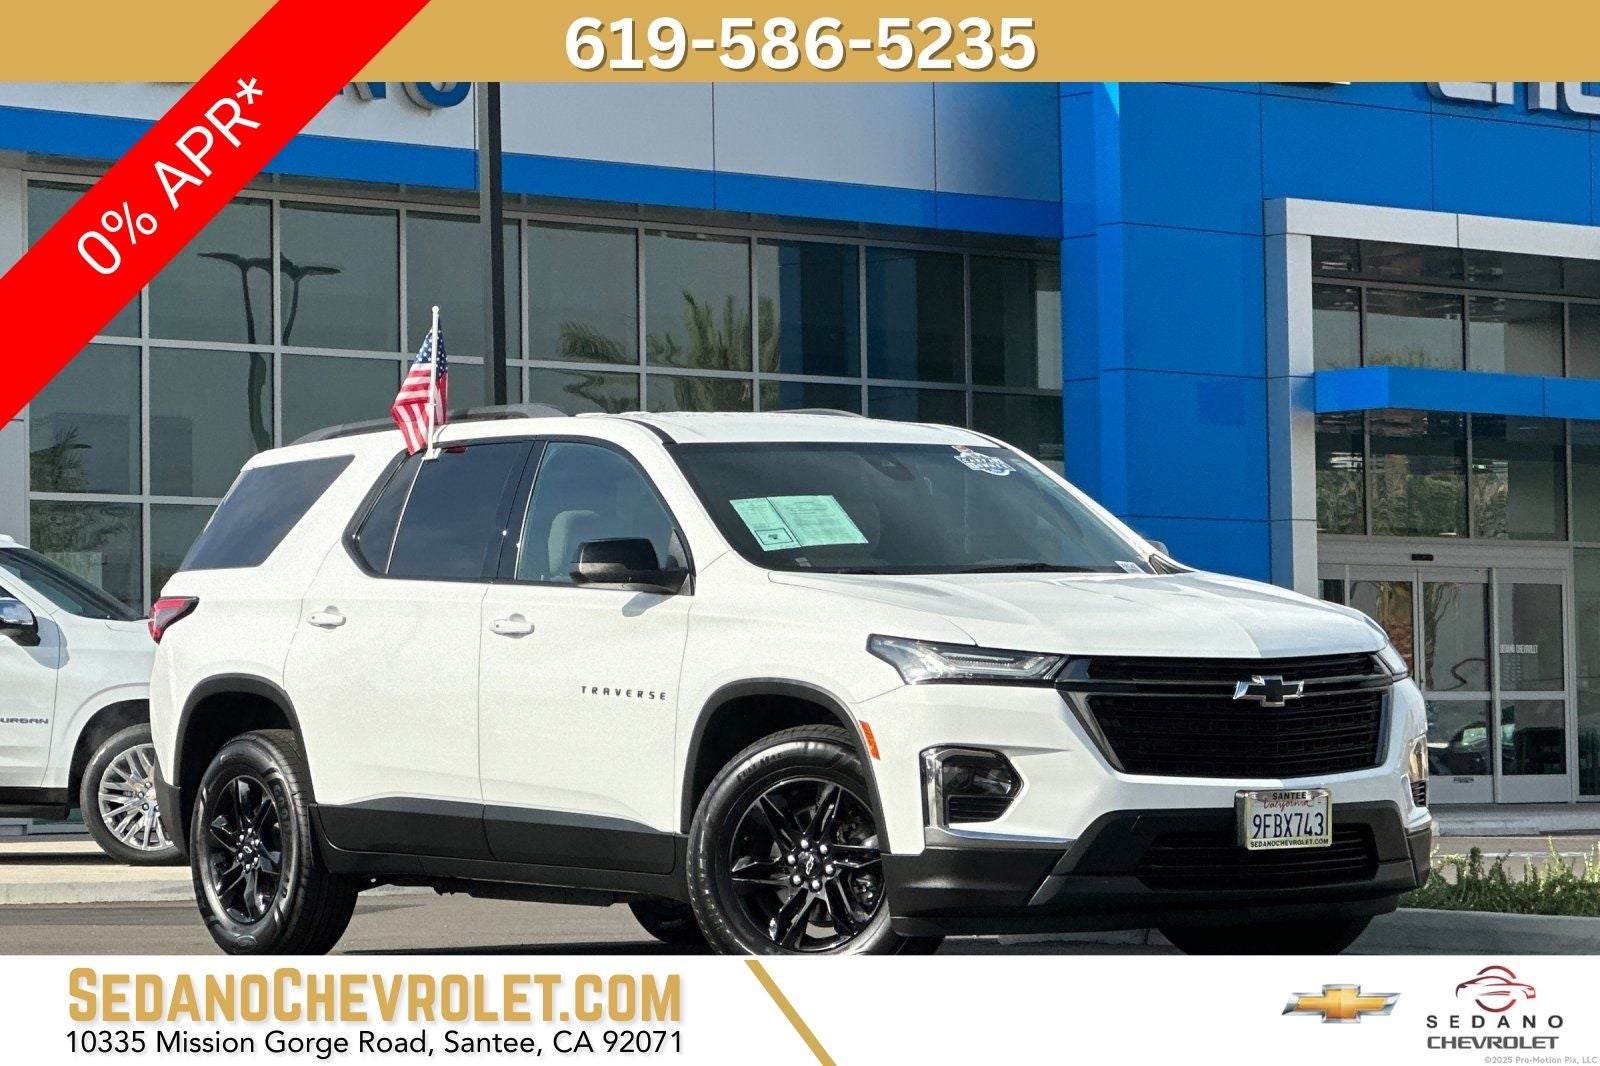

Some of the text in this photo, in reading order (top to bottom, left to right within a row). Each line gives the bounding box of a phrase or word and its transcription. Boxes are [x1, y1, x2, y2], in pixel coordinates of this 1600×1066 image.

[581, 686, 666, 701] TRAVERSE
[1272, 791, 1307, 801] SANTEE
[1263, 800, 1314, 812] California
[1252, 812, 1324, 839] 9FBX743
[1250, 839, 1329, 848] SEDANOCHEVROLET.COM
